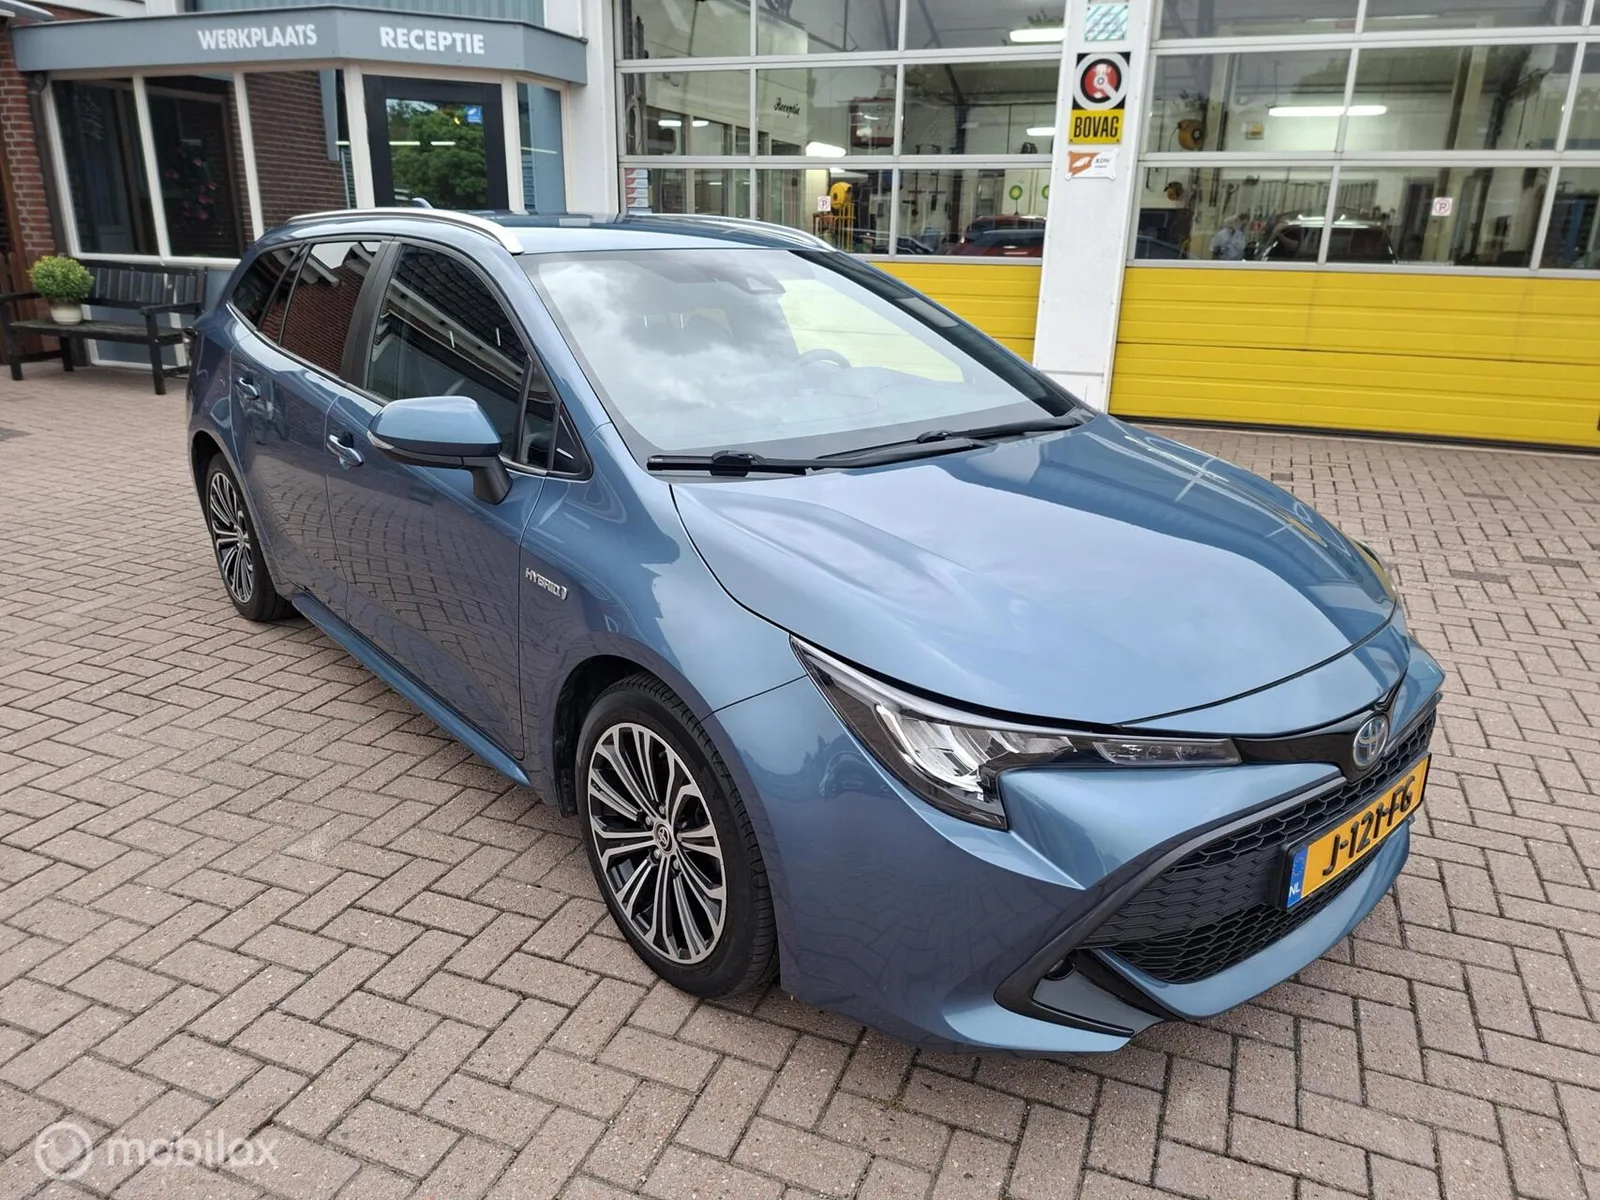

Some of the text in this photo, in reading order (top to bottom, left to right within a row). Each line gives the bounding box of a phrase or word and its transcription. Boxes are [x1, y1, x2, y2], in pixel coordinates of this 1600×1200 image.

[197, 24, 318, 50] WERKPLAATS
[379, 26, 485, 55] RECEPTIE
[1073, 115, 1120, 138] BOVAG
[525, 567, 561, 598] HYBRID
[1288, 882, 1301, 897] NL
